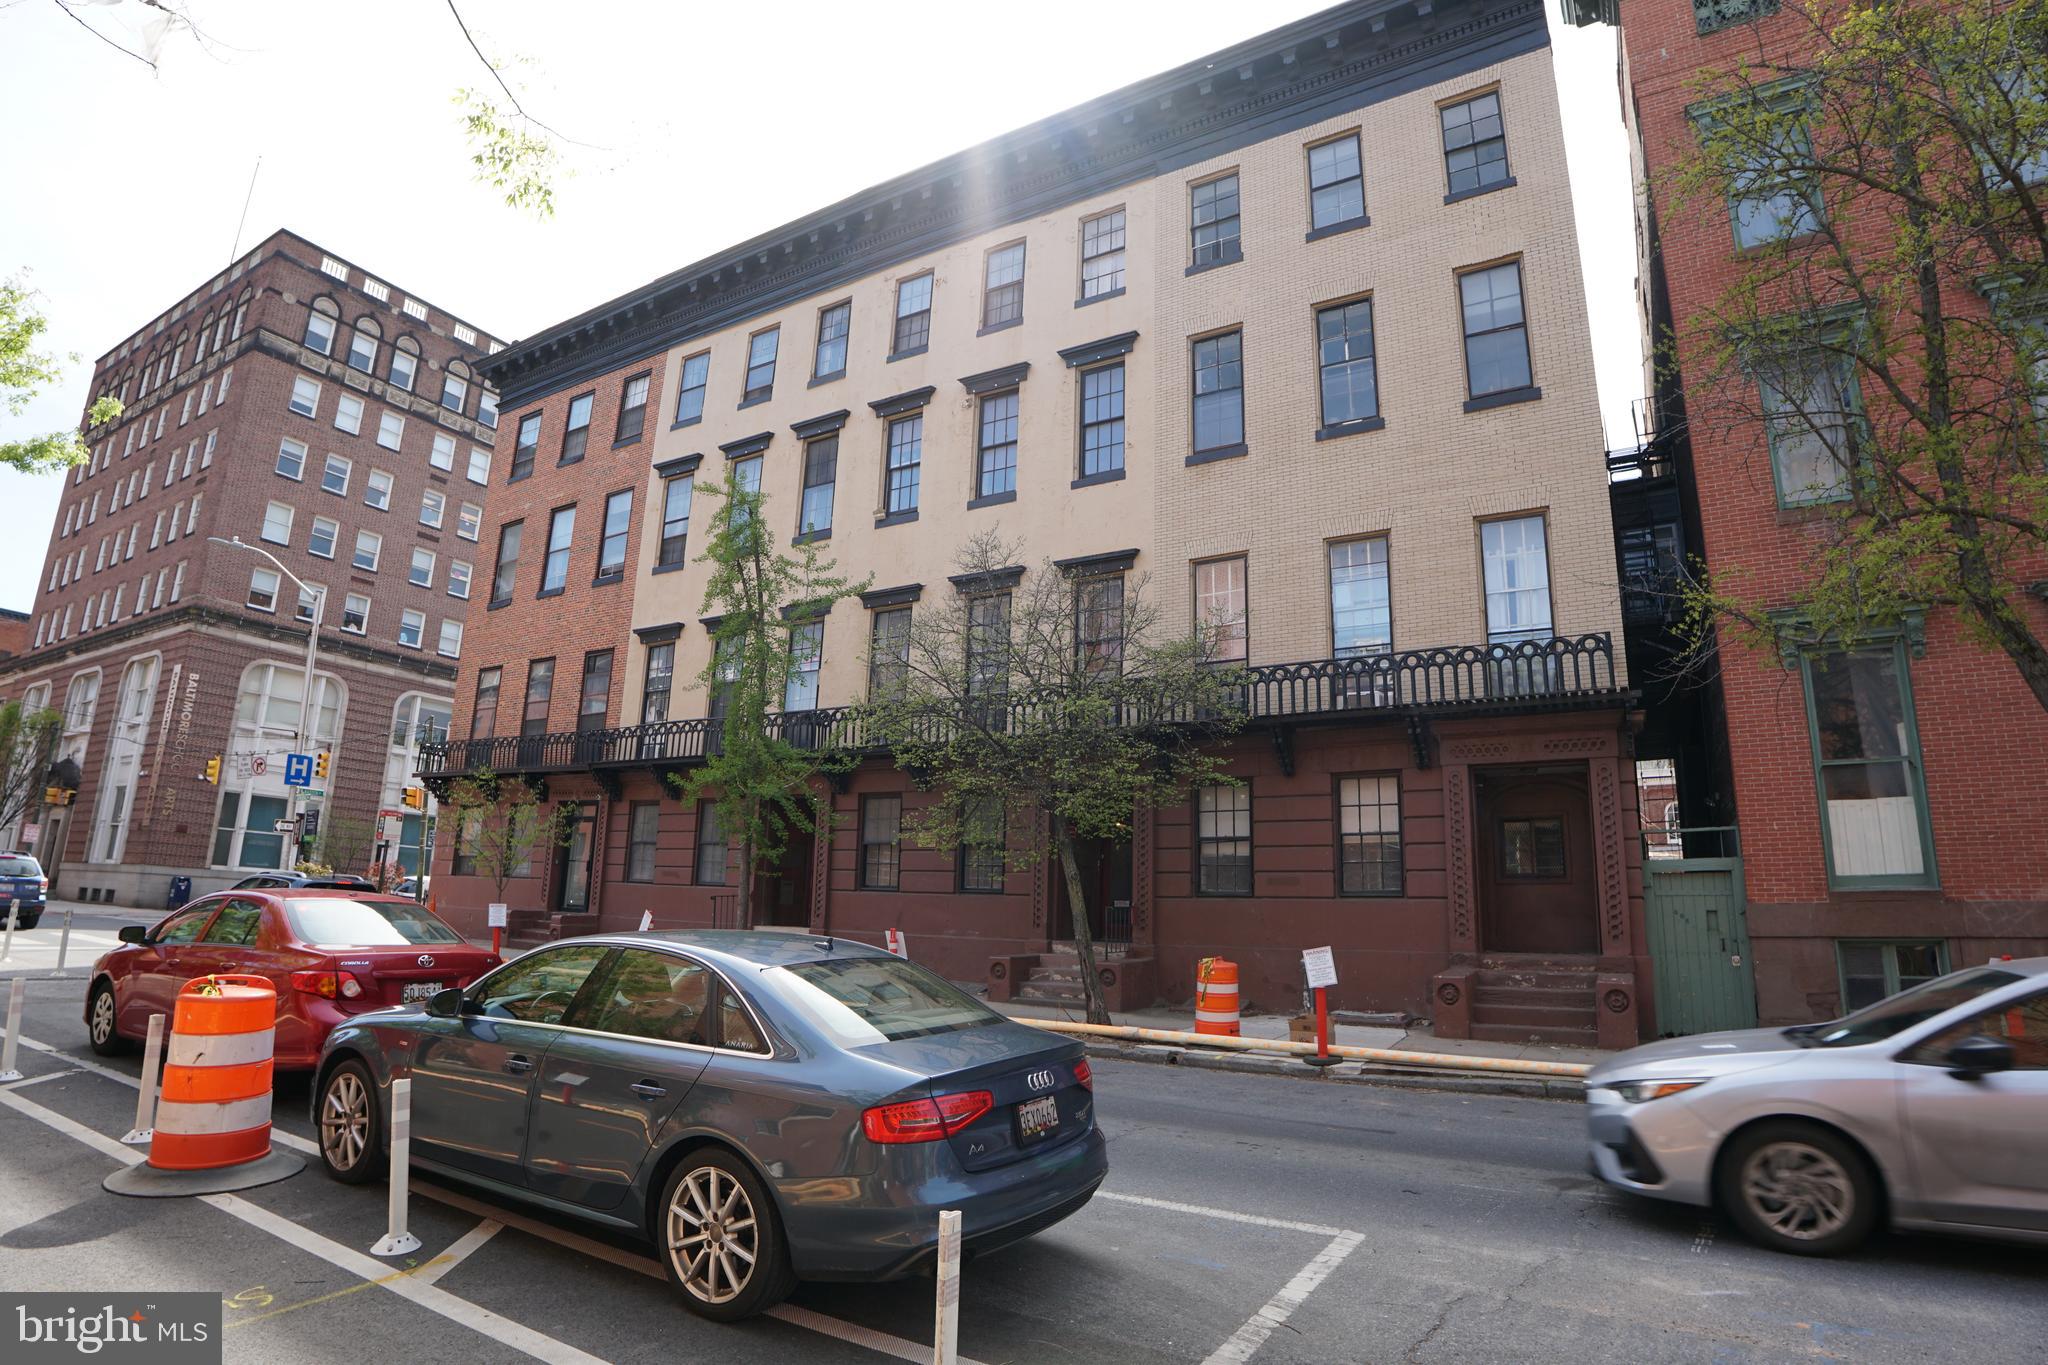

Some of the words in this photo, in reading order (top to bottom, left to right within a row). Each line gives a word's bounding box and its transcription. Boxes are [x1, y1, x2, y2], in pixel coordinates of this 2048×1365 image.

[177, 673, 200, 734] BALTIMORE
[290, 757, 309, 777] H
[162, 787, 177, 816] ARTS
[969, 1144, 985, 1155] A4
